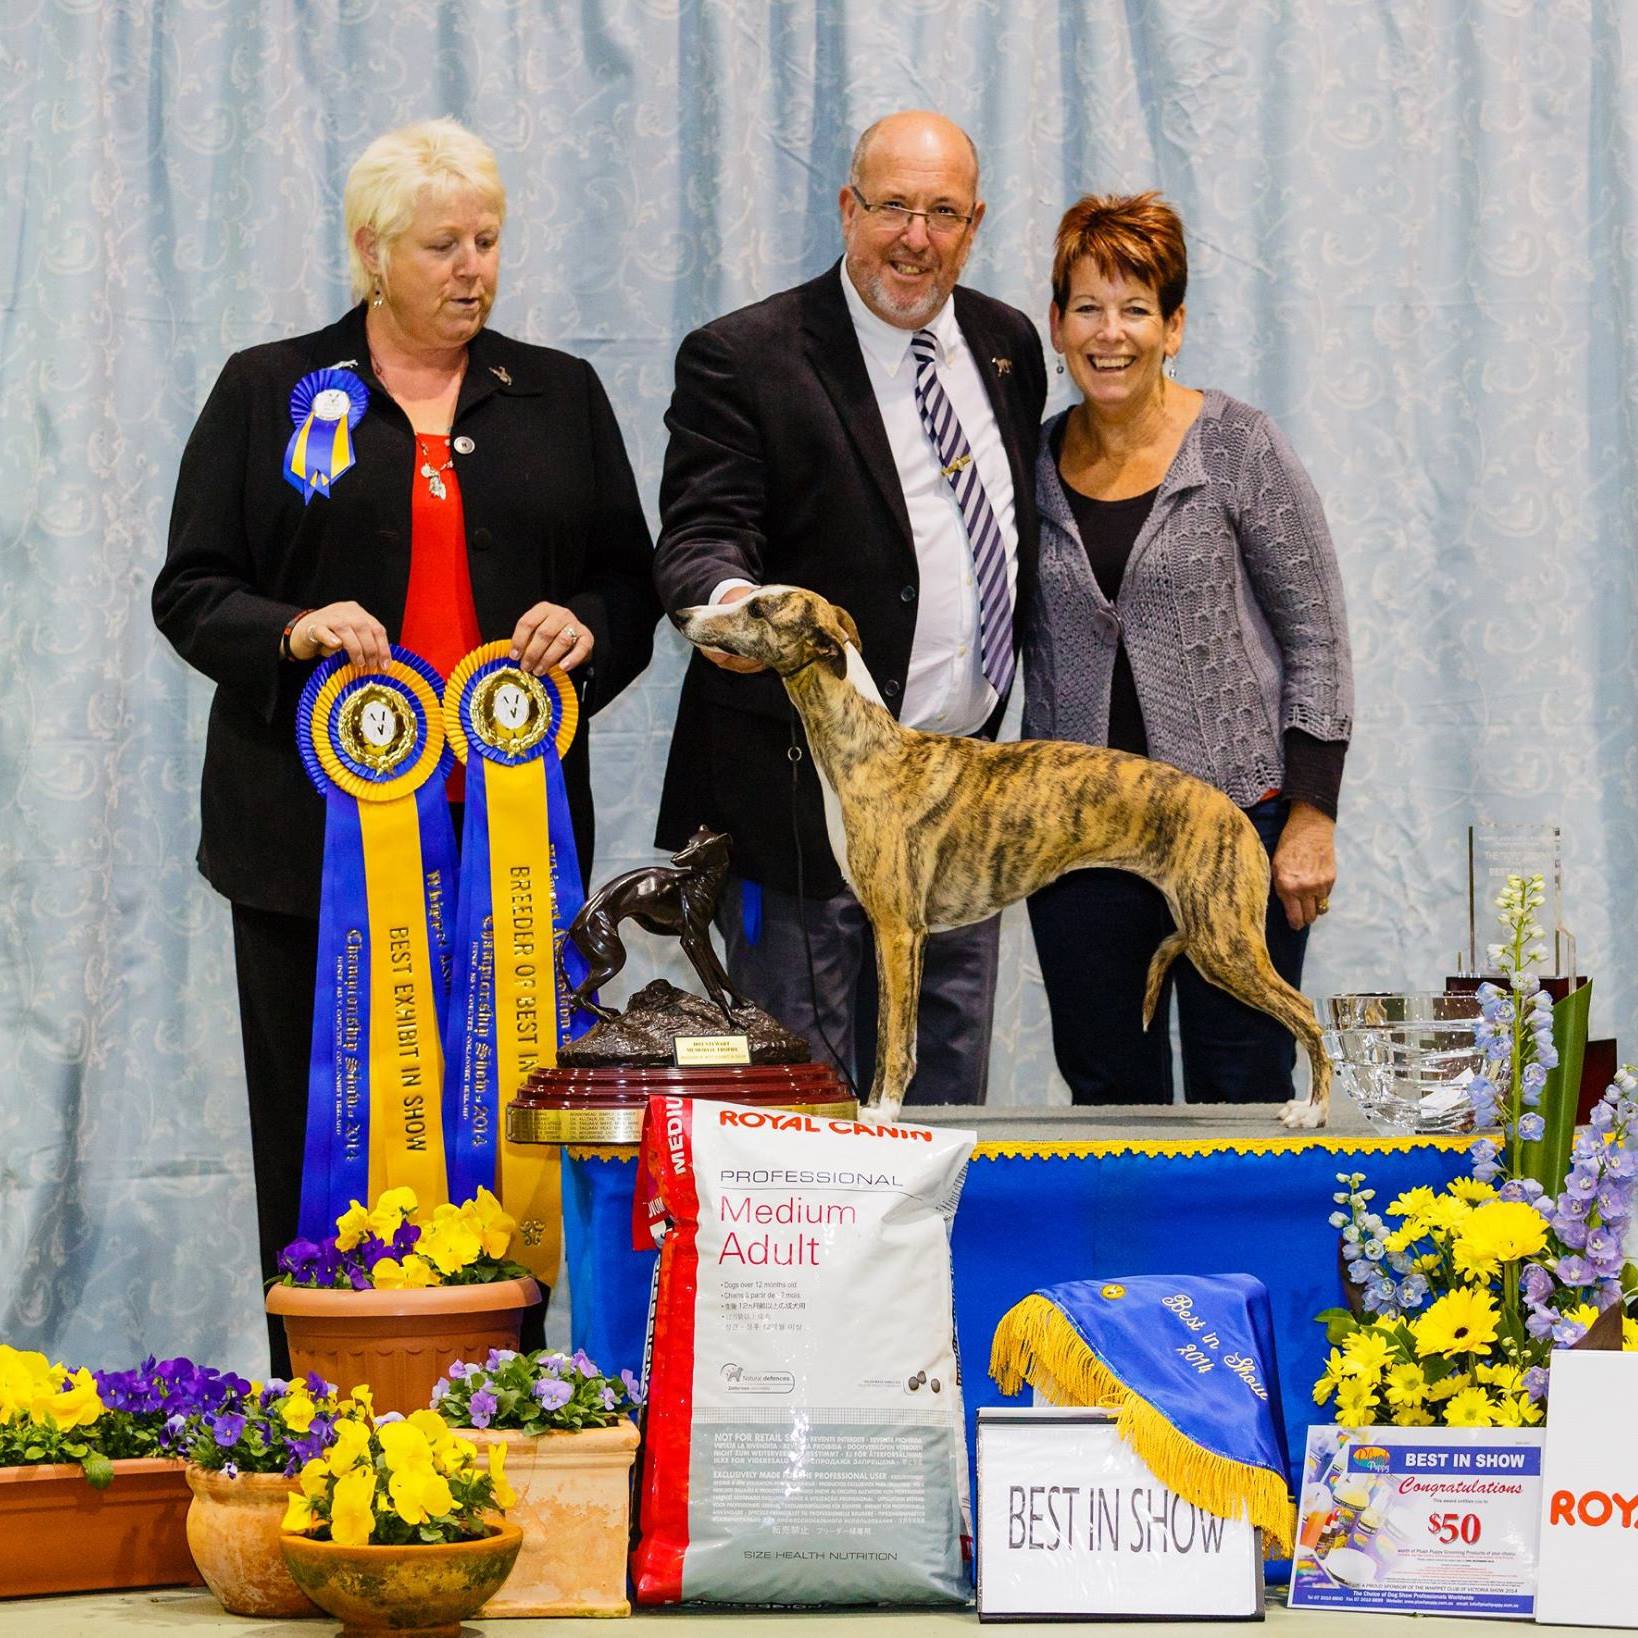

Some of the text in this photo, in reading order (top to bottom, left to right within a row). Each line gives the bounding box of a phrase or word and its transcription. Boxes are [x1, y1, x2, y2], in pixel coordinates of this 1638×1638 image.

[510, 866, 536, 956] BREEDER
[514, 964, 537, 988] OF
[515, 997, 539, 1045] BEST
[389, 926, 427, 1152] BEST EXHIBIT IN SHOW
[474, 1042, 492, 1093] Show
[518, 1053, 540, 1073] IN
[344, 1122, 361, 1162] 2014
[471, 1105, 490, 1148] 2014
[665, 1096, 687, 1175] MEDIU
[719, 1109, 933, 1143] ROYAL CANIN
[720, 1169, 904, 1187] PROFESSIONAL
[720, 1195, 856, 1225] Medium
[718, 1231, 820, 1266] Adult
[1161, 1294, 1269, 1401] Best in Show
[1175, 1343, 1216, 1374] 2014
[714, 1433, 733, 1441] NOT
[735, 1433, 752, 1441] FOR
[754, 1433, 781, 1441] RETAIL
[759, 1471, 781, 1479] MADE
[814, 1471, 868, 1479] PROFESSIONAL
[870, 1472, 887, 1480] USER
[1405, 1453, 1525, 1468] BEST IN SHOW
[1399, 1476, 1524, 1497] Congratulations
[1008, 1485, 1224, 1554] BEST IN SHOW
[1550, 1490, 1638, 1529] ROY
[1428, 1511, 1482, 1545] $50
[744, 1551, 898, 1561] SIZE HEALTH NUTRITION
